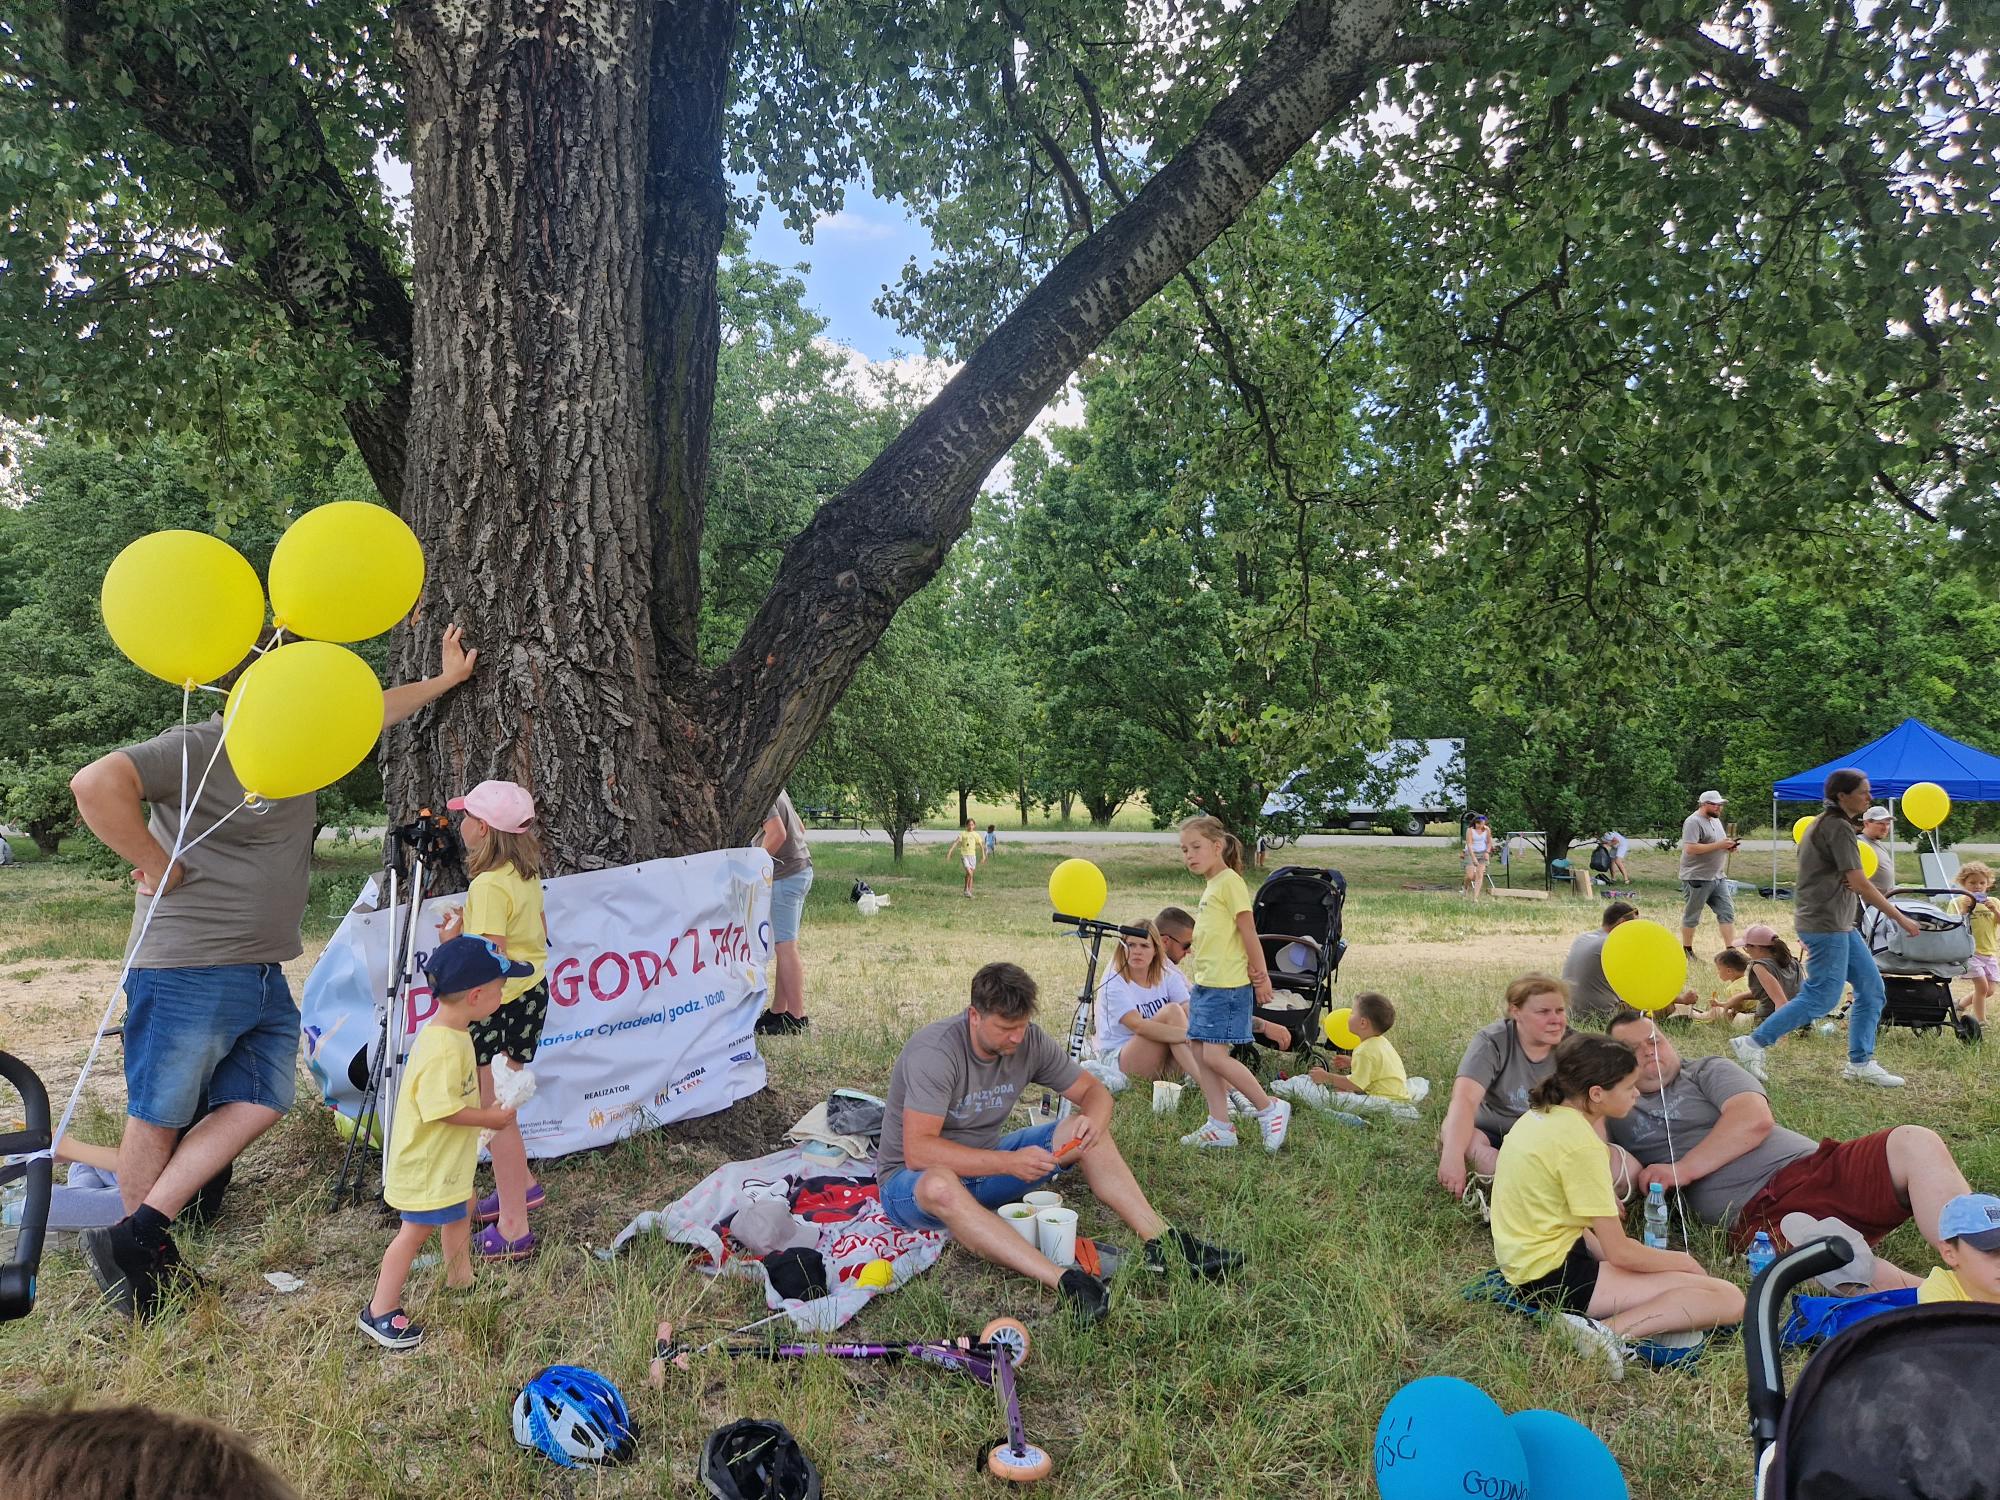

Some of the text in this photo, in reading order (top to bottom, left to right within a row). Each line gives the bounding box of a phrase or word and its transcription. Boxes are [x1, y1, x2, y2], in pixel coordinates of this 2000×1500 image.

[684, 928, 706, 974] Z
[537, 990, 725, 1047] ańska Cytadela) godz. 10:00
[728, 1032, 755, 1049] PATRONA
[584, 1084, 630, 1101] REALIZATOR
[674, 1087, 682, 1096] Z
